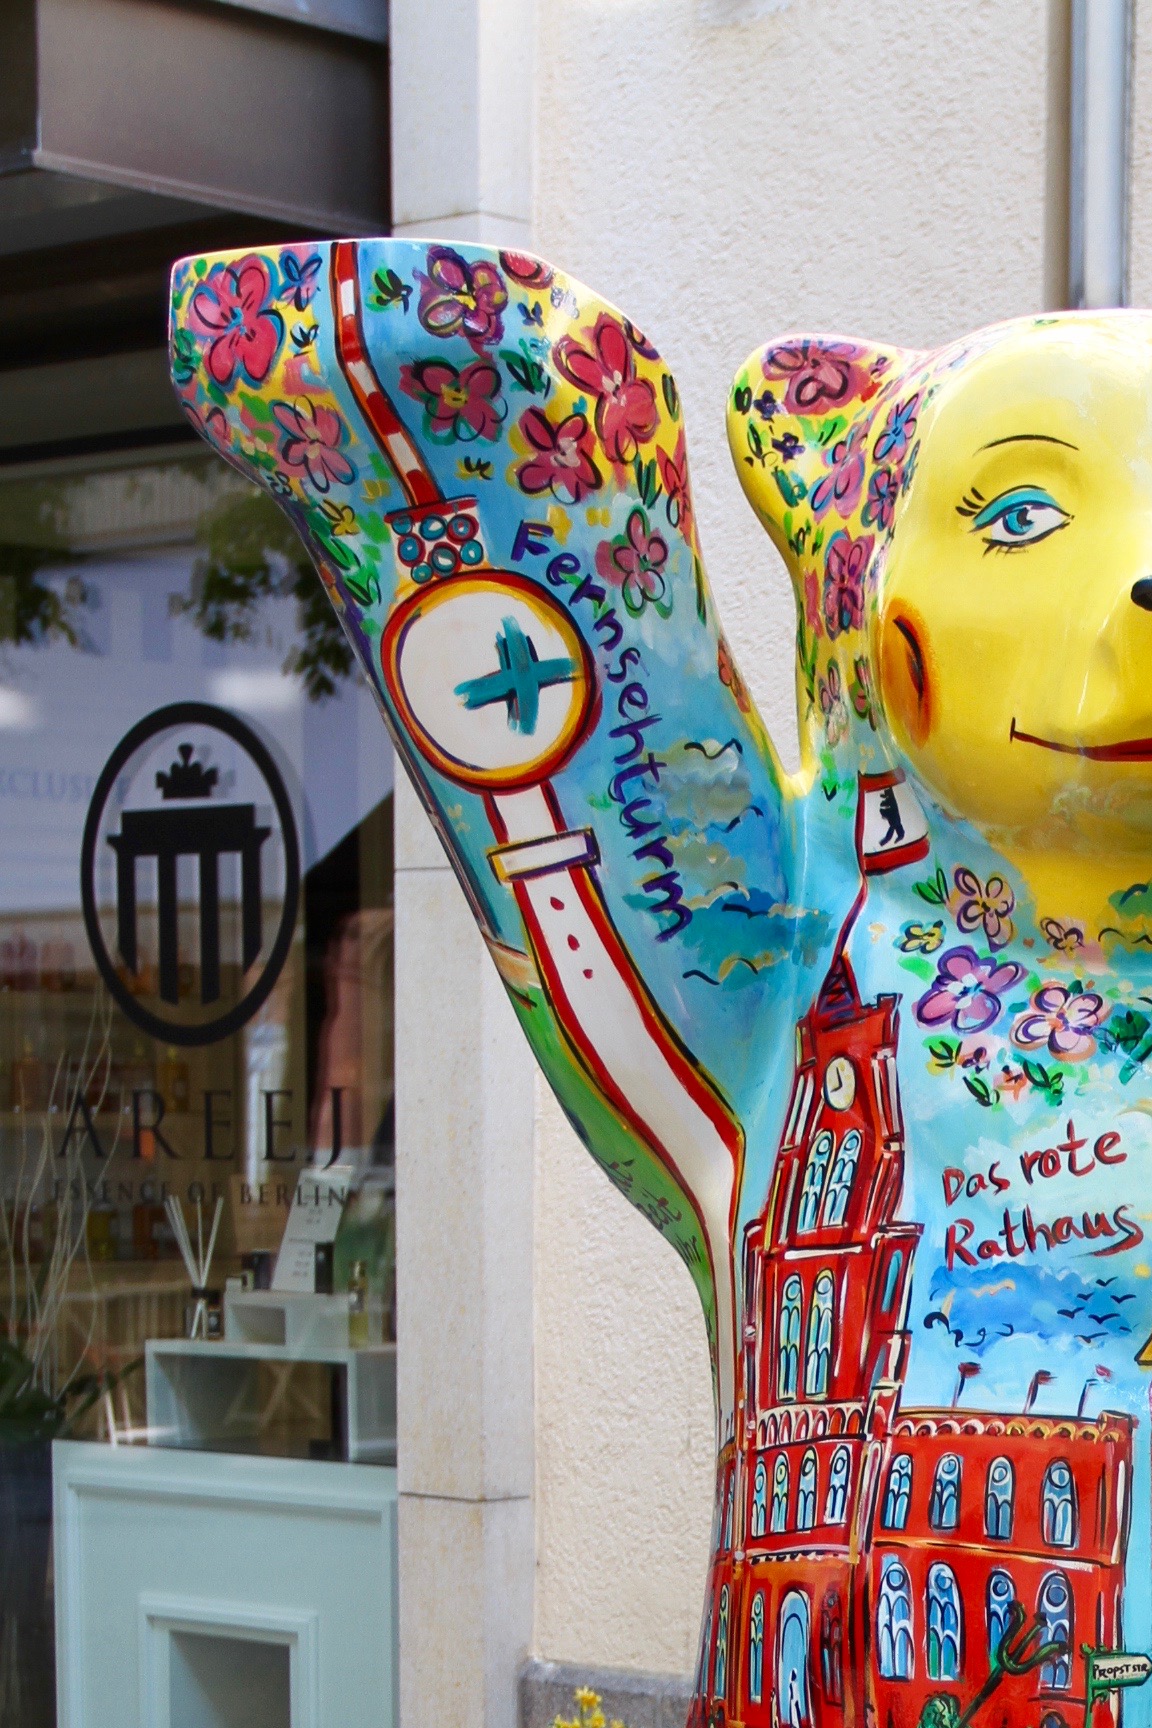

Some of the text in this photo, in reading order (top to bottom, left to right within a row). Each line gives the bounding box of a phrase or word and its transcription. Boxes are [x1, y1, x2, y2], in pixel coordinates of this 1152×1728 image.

[511, 518, 694, 943] Fernsehturm
[58, 1086, 344, 1169] AREEJ
[941, 1118, 1128, 1208] Das rote
[53, 1179, 347, 1206] ESSENCE OF BERLIN
[944, 1203, 1144, 1272] Rathaus
